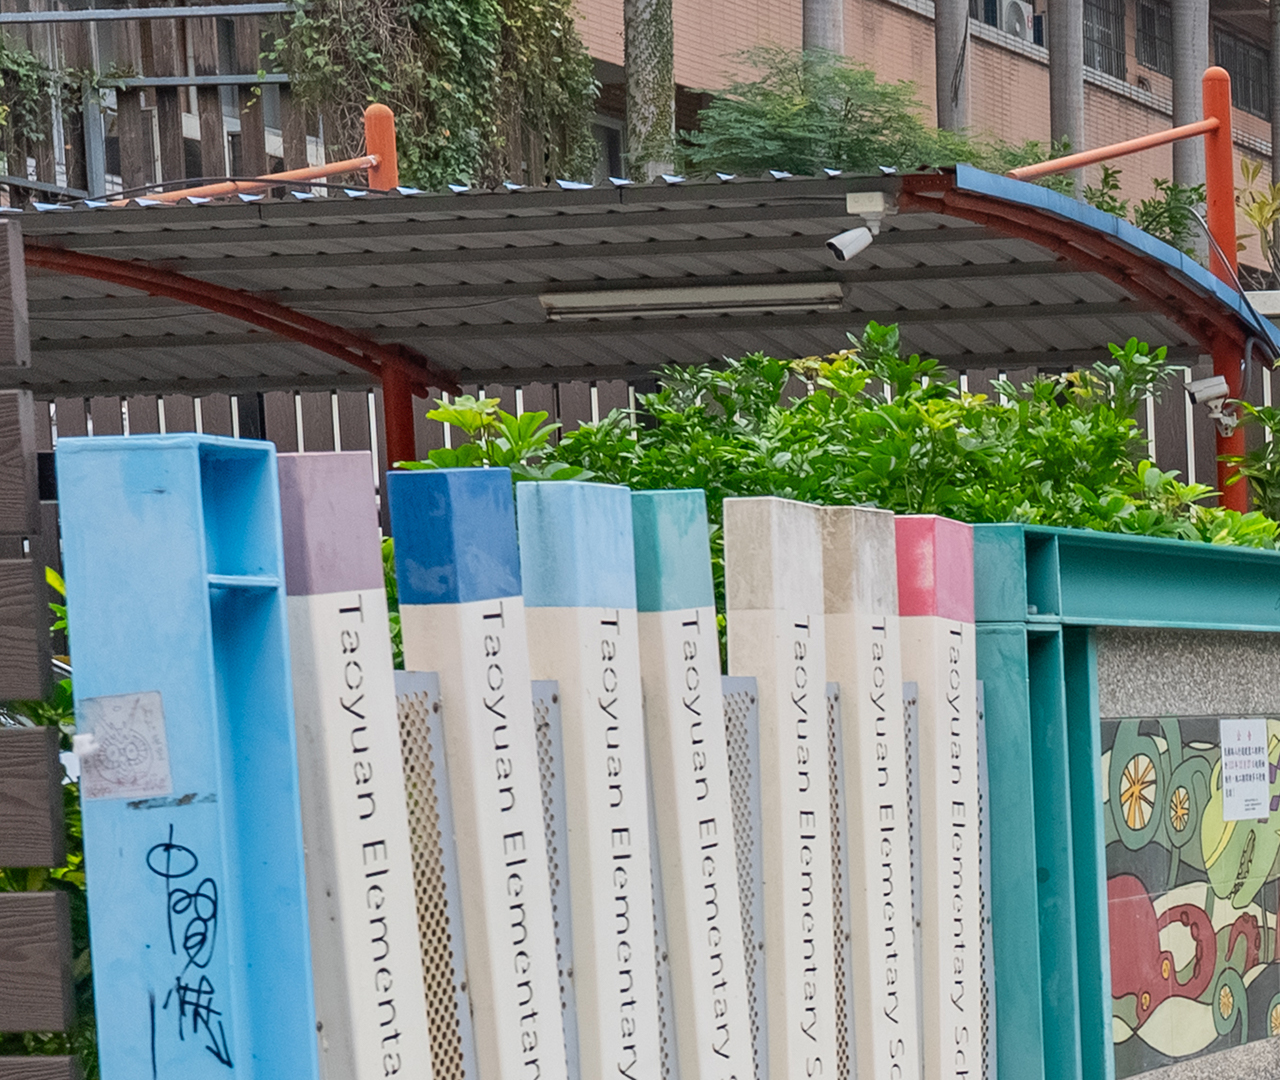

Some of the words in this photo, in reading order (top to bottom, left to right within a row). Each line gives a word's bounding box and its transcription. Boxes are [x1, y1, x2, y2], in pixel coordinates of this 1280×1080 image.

[338, 595, 376, 820] Taoyuan
[482, 601, 515, 813] Taoyuan
[599, 610, 622, 808] Taoyuan
[791, 615, 810, 793] Taoyuan
[946, 623, 962, 786] Taoyuan
[682, 610, 708, 801] Taoyuan
[699, 816, 730, 1060] Elementary
[800, 810, 817, 1042] Elementary
[870, 617, 888, 788] Taoyuan
[880, 803, 898, 1025] Elementary
[951, 800, 966, 1013] Elementary
